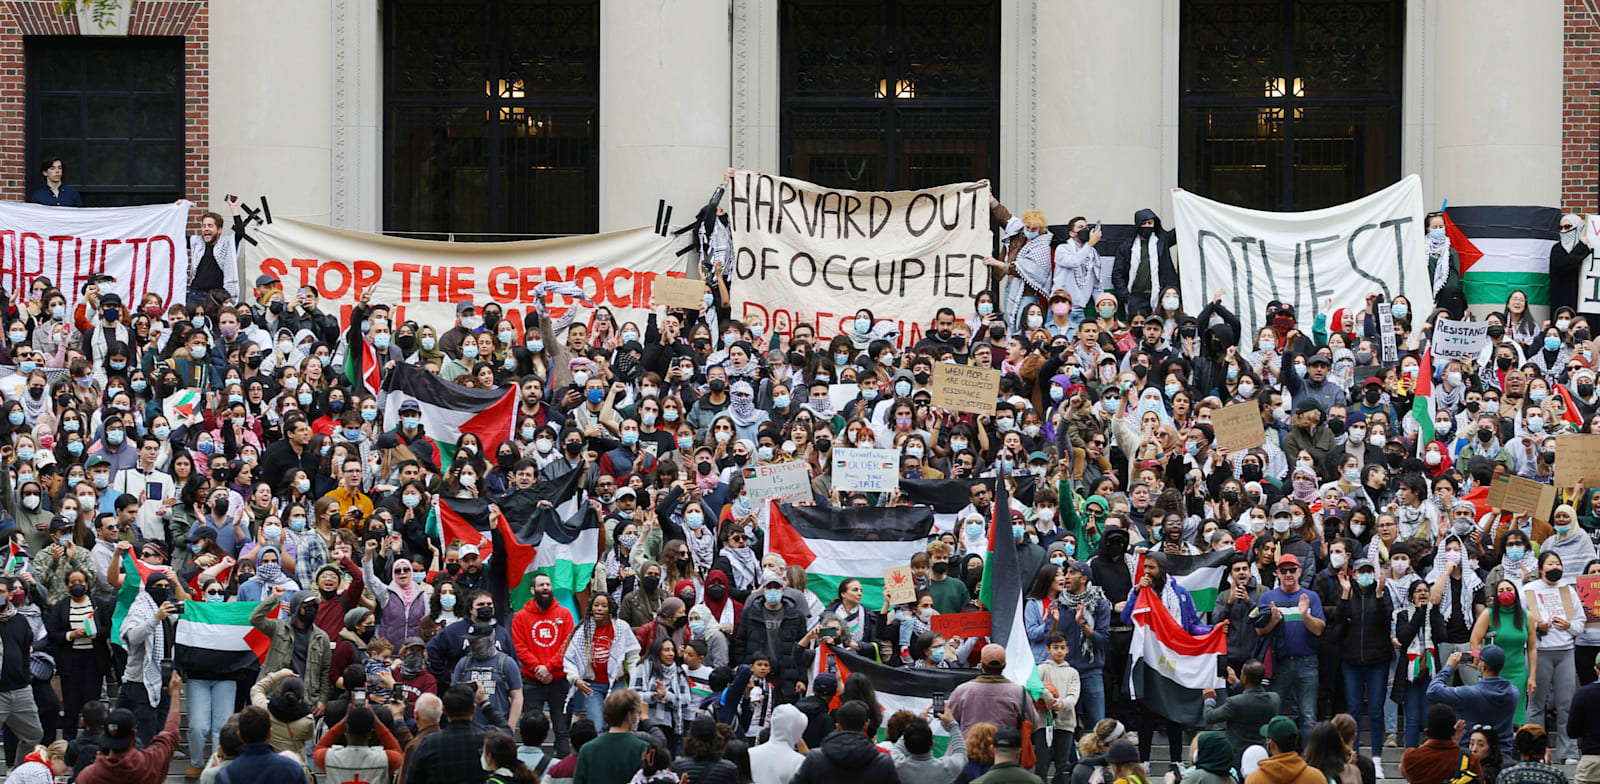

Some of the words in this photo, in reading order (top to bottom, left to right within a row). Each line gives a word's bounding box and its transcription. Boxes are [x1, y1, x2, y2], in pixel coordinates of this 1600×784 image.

[730, 174, 892, 239] HARVARD
[905, 183, 988, 237] OUT
[735, 247, 780, 280] OF
[789, 252, 992, 299] OCCUPIED
[253, 258, 383, 302] STOP
[392, 262, 475, 304] THE
[488, 265, 687, 310] GENOCID
[1198, 216, 1413, 343] DIVEST
[1437, 319, 1486, 337] RESISTANC
[945, 367, 964, 377] WHEN
[945, 377, 959, 385] ARE
[834, 449, 845, 457] MY
[848, 460, 881, 471] OLDER
[772, 475, 784, 484] IS
[847, 479, 882, 489] STATE
